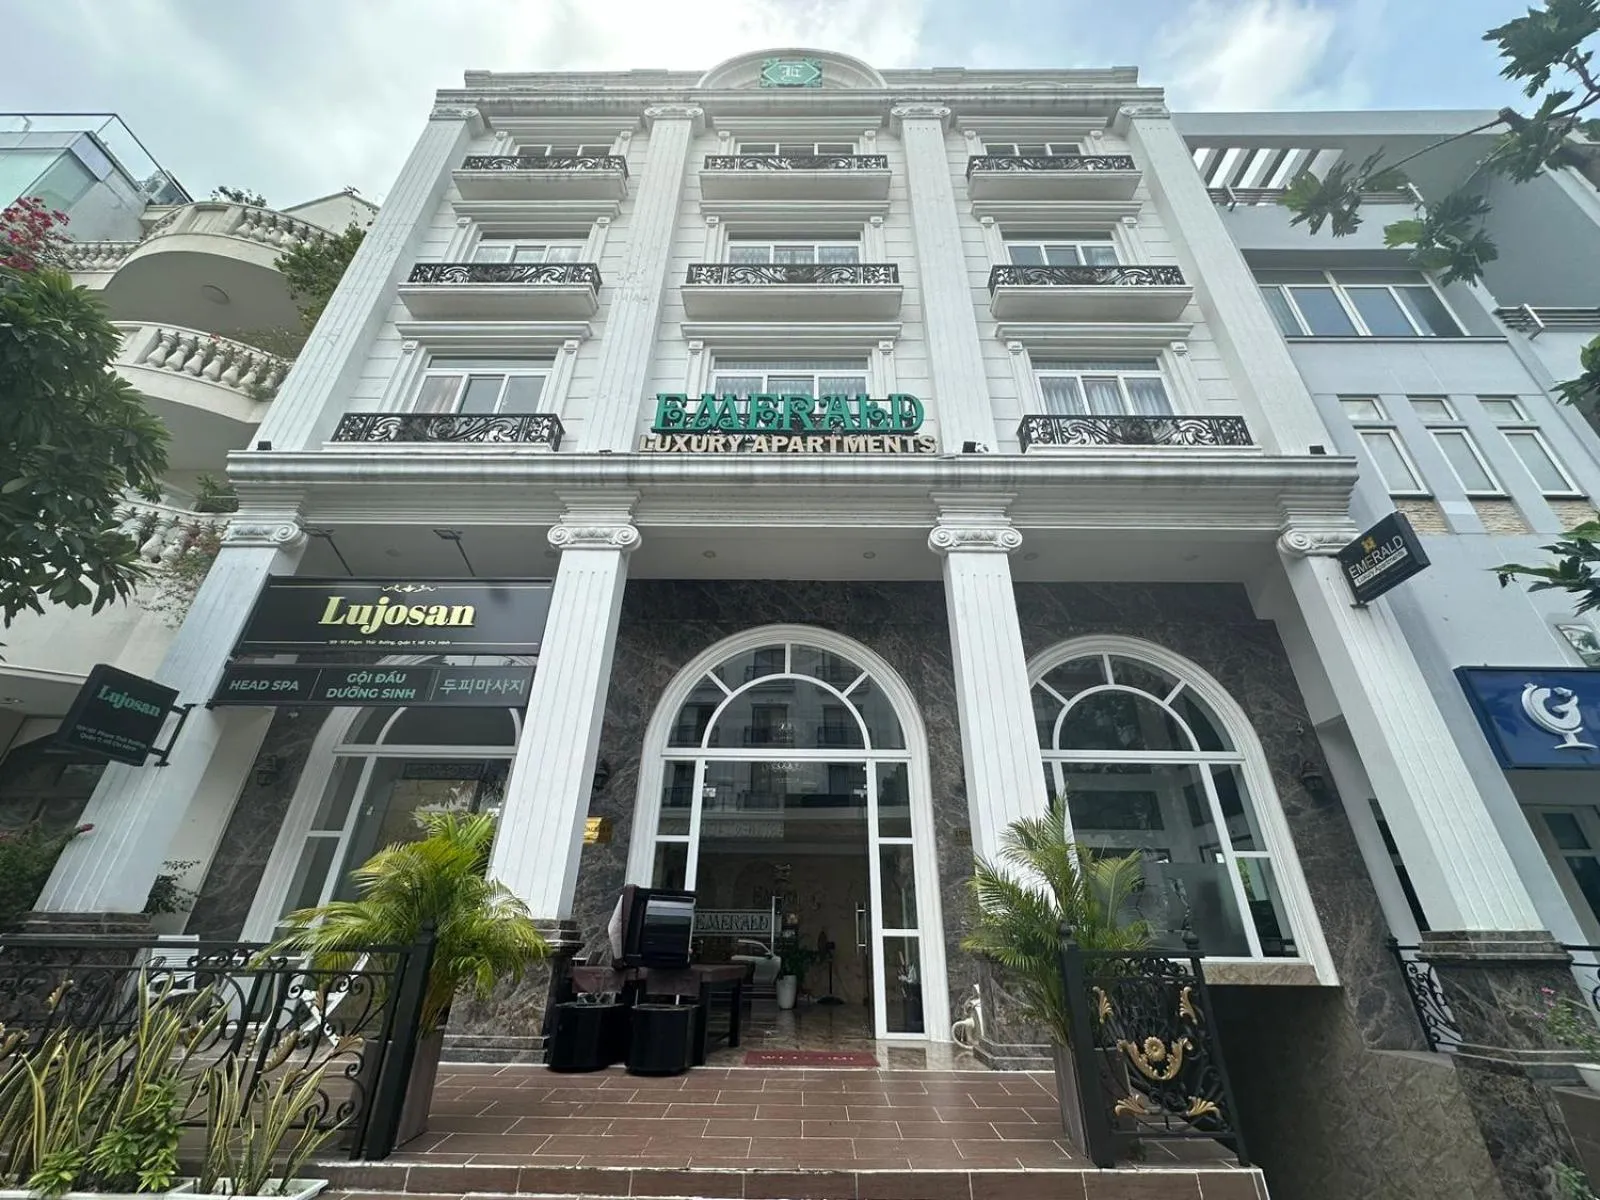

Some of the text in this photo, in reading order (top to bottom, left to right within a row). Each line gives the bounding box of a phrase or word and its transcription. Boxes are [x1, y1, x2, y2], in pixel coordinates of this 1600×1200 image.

[651, 393, 925, 434] EMERALD
[639, 434, 938, 454] LUXURY APARTMENTS
[1348, 535, 1404, 579] EMERALD
[318, 596, 475, 634] Lujosan
[229, 679, 300, 692] HEAD SPA
[346, 670, 407, 686] GỘI ĐẤU
[439, 678, 526, 696] 두피마사지
[96, 685, 161, 717] Lujosan
[326, 686, 417, 699] DƯỠNG SINH
[696, 913, 769, 930] EMERALD
